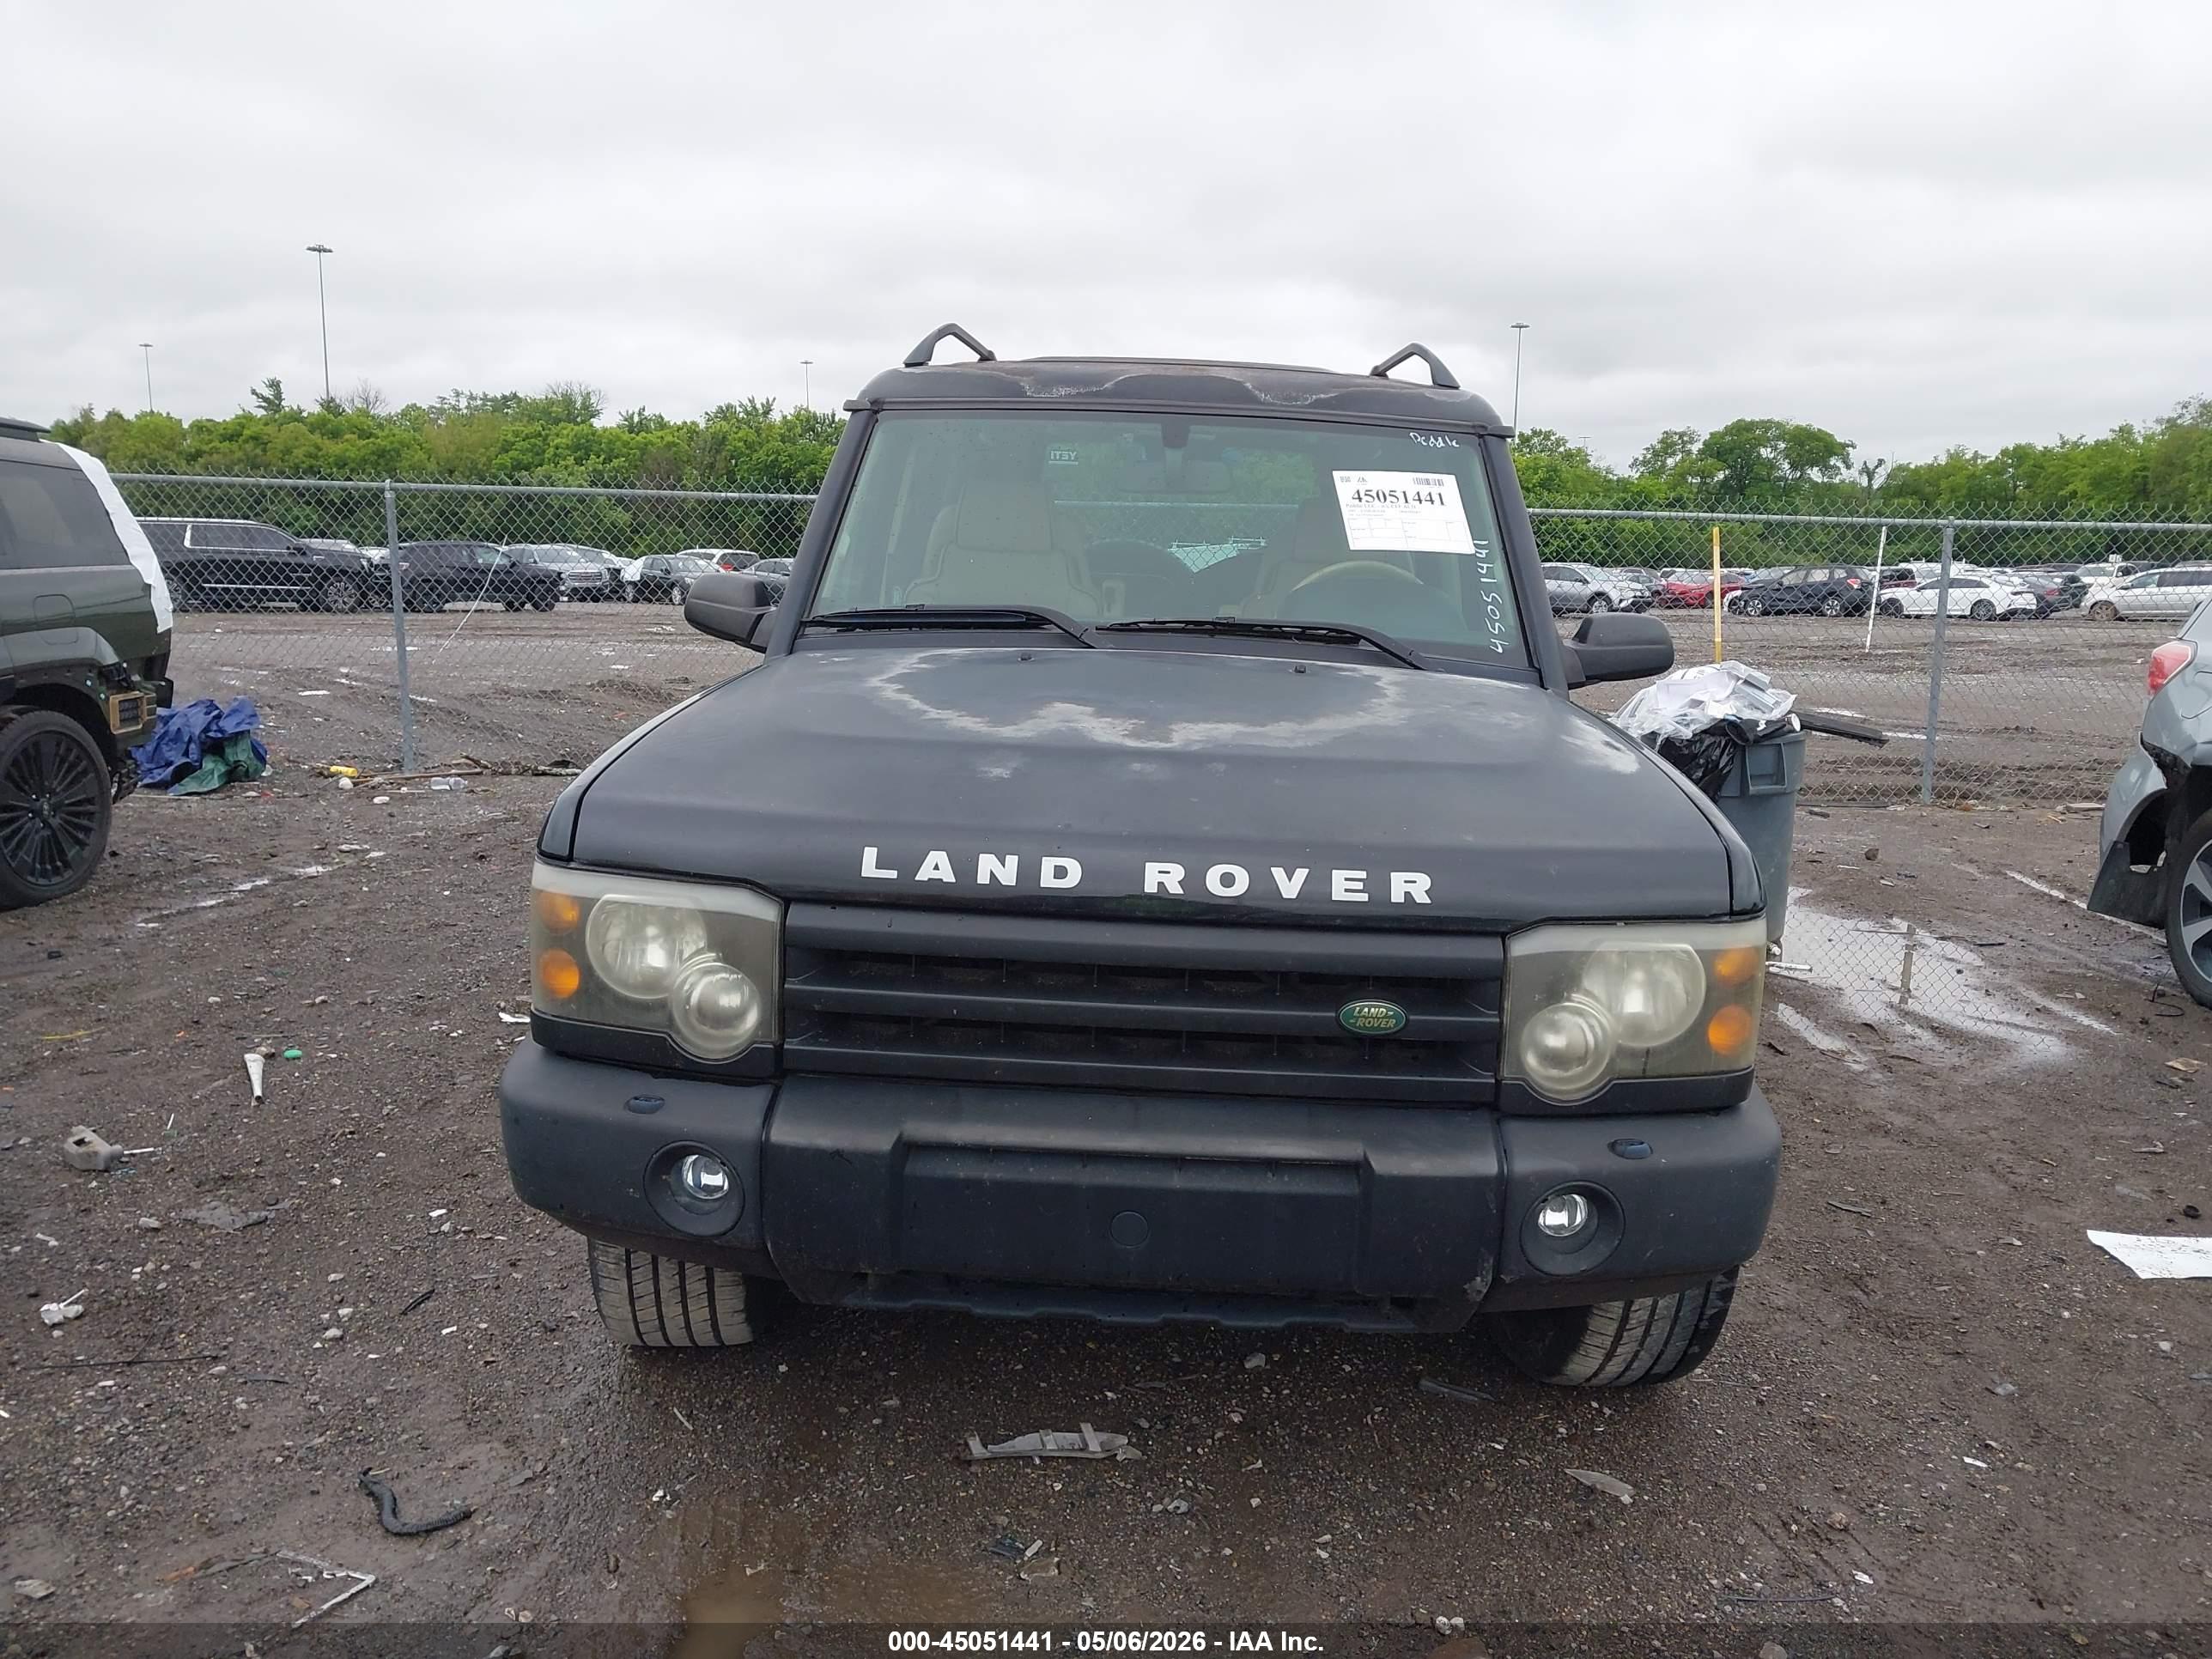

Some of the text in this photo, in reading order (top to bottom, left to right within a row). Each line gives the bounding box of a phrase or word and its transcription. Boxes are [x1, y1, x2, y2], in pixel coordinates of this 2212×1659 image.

[1351, 489, 1447, 507] 45051441
[1473, 539, 1510, 653] 45051441
[860, 846, 1433, 904] LAND ROVER
